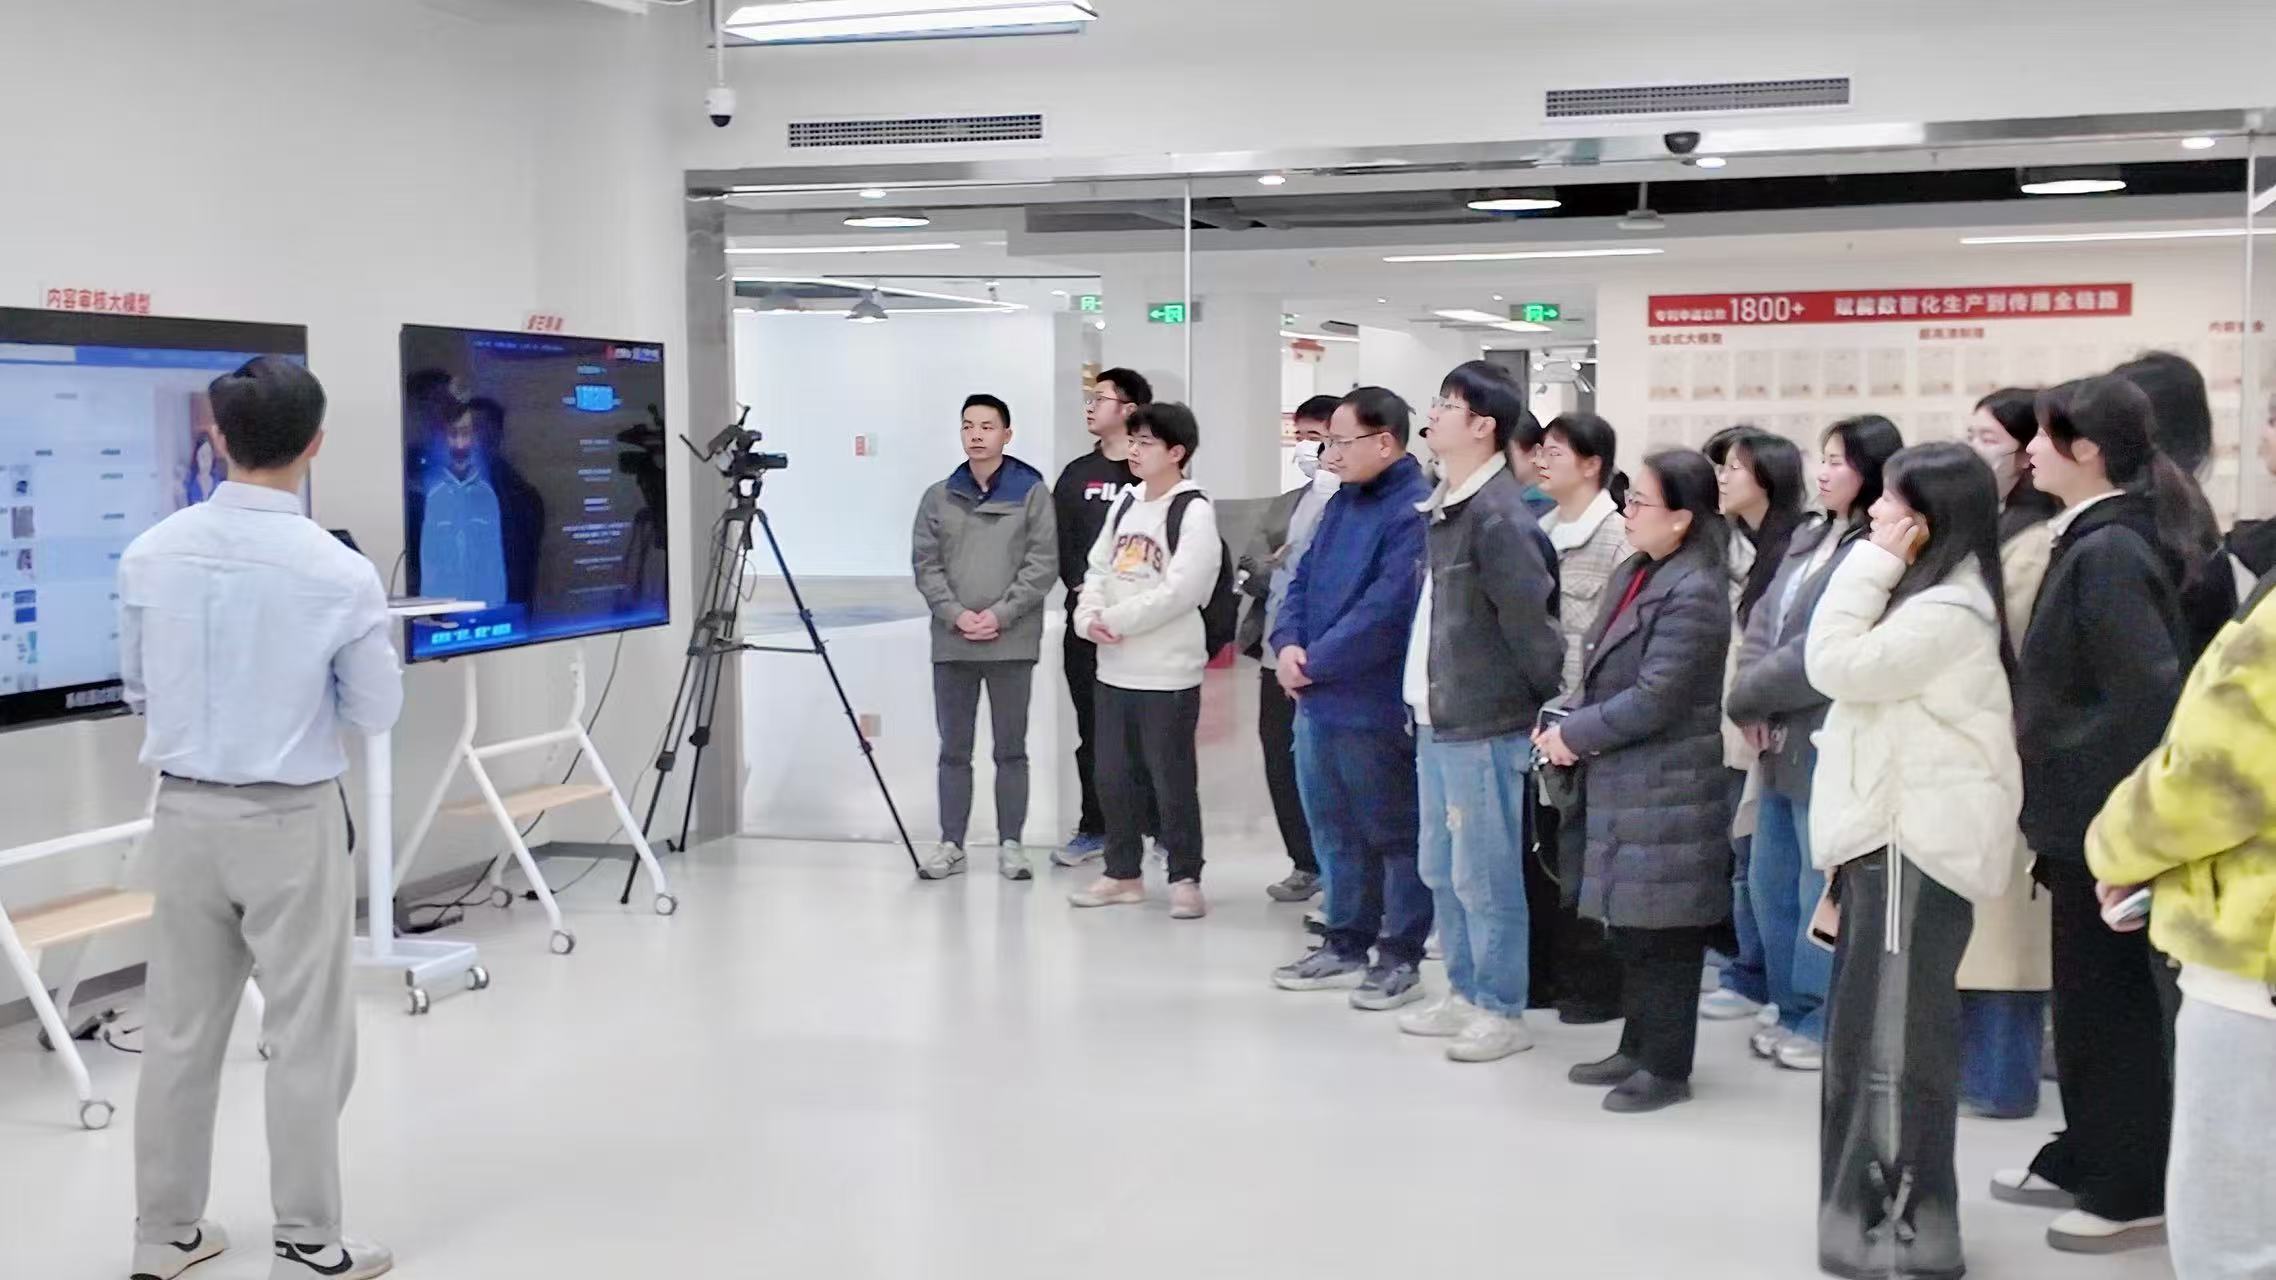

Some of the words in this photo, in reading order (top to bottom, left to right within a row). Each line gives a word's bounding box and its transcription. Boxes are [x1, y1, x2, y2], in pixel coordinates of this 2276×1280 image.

[46, 288, 151, 314] 内容审核大模型
[1729, 296, 1805, 322] 1800+
[1084, 480, 1131, 501] FIL
